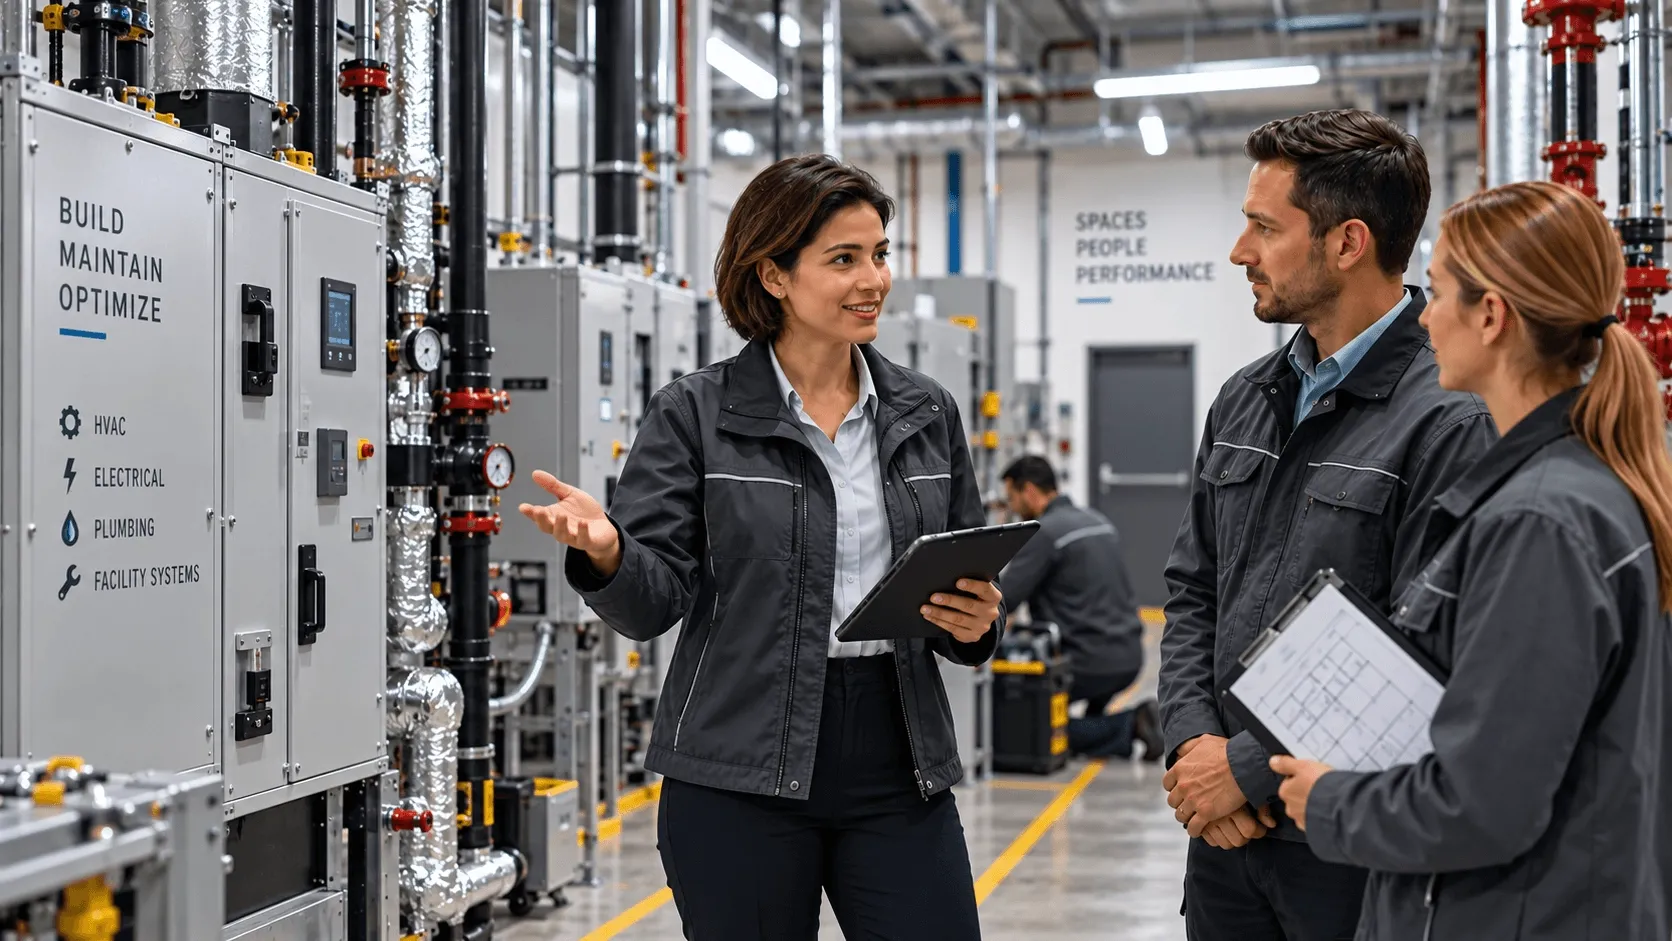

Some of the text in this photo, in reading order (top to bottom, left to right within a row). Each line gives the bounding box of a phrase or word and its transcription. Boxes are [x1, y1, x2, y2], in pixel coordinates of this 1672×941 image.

[60, 197, 123, 234] BUILD
[1076, 212, 1147, 231] SPACES
[1076, 238, 1146, 257] PEOPLE
[60, 241, 162, 282] MAINTAIN
[1076, 263, 1214, 283] PERFORMANCE
[60, 284, 162, 322] OPTIMIZE
[95, 415, 125, 436] HVAC
[95, 467, 165, 487] ELECTRICAL
[95, 518, 155, 538] PLUMBING
[95, 565, 200, 590] FACILITY SYSTEMS
